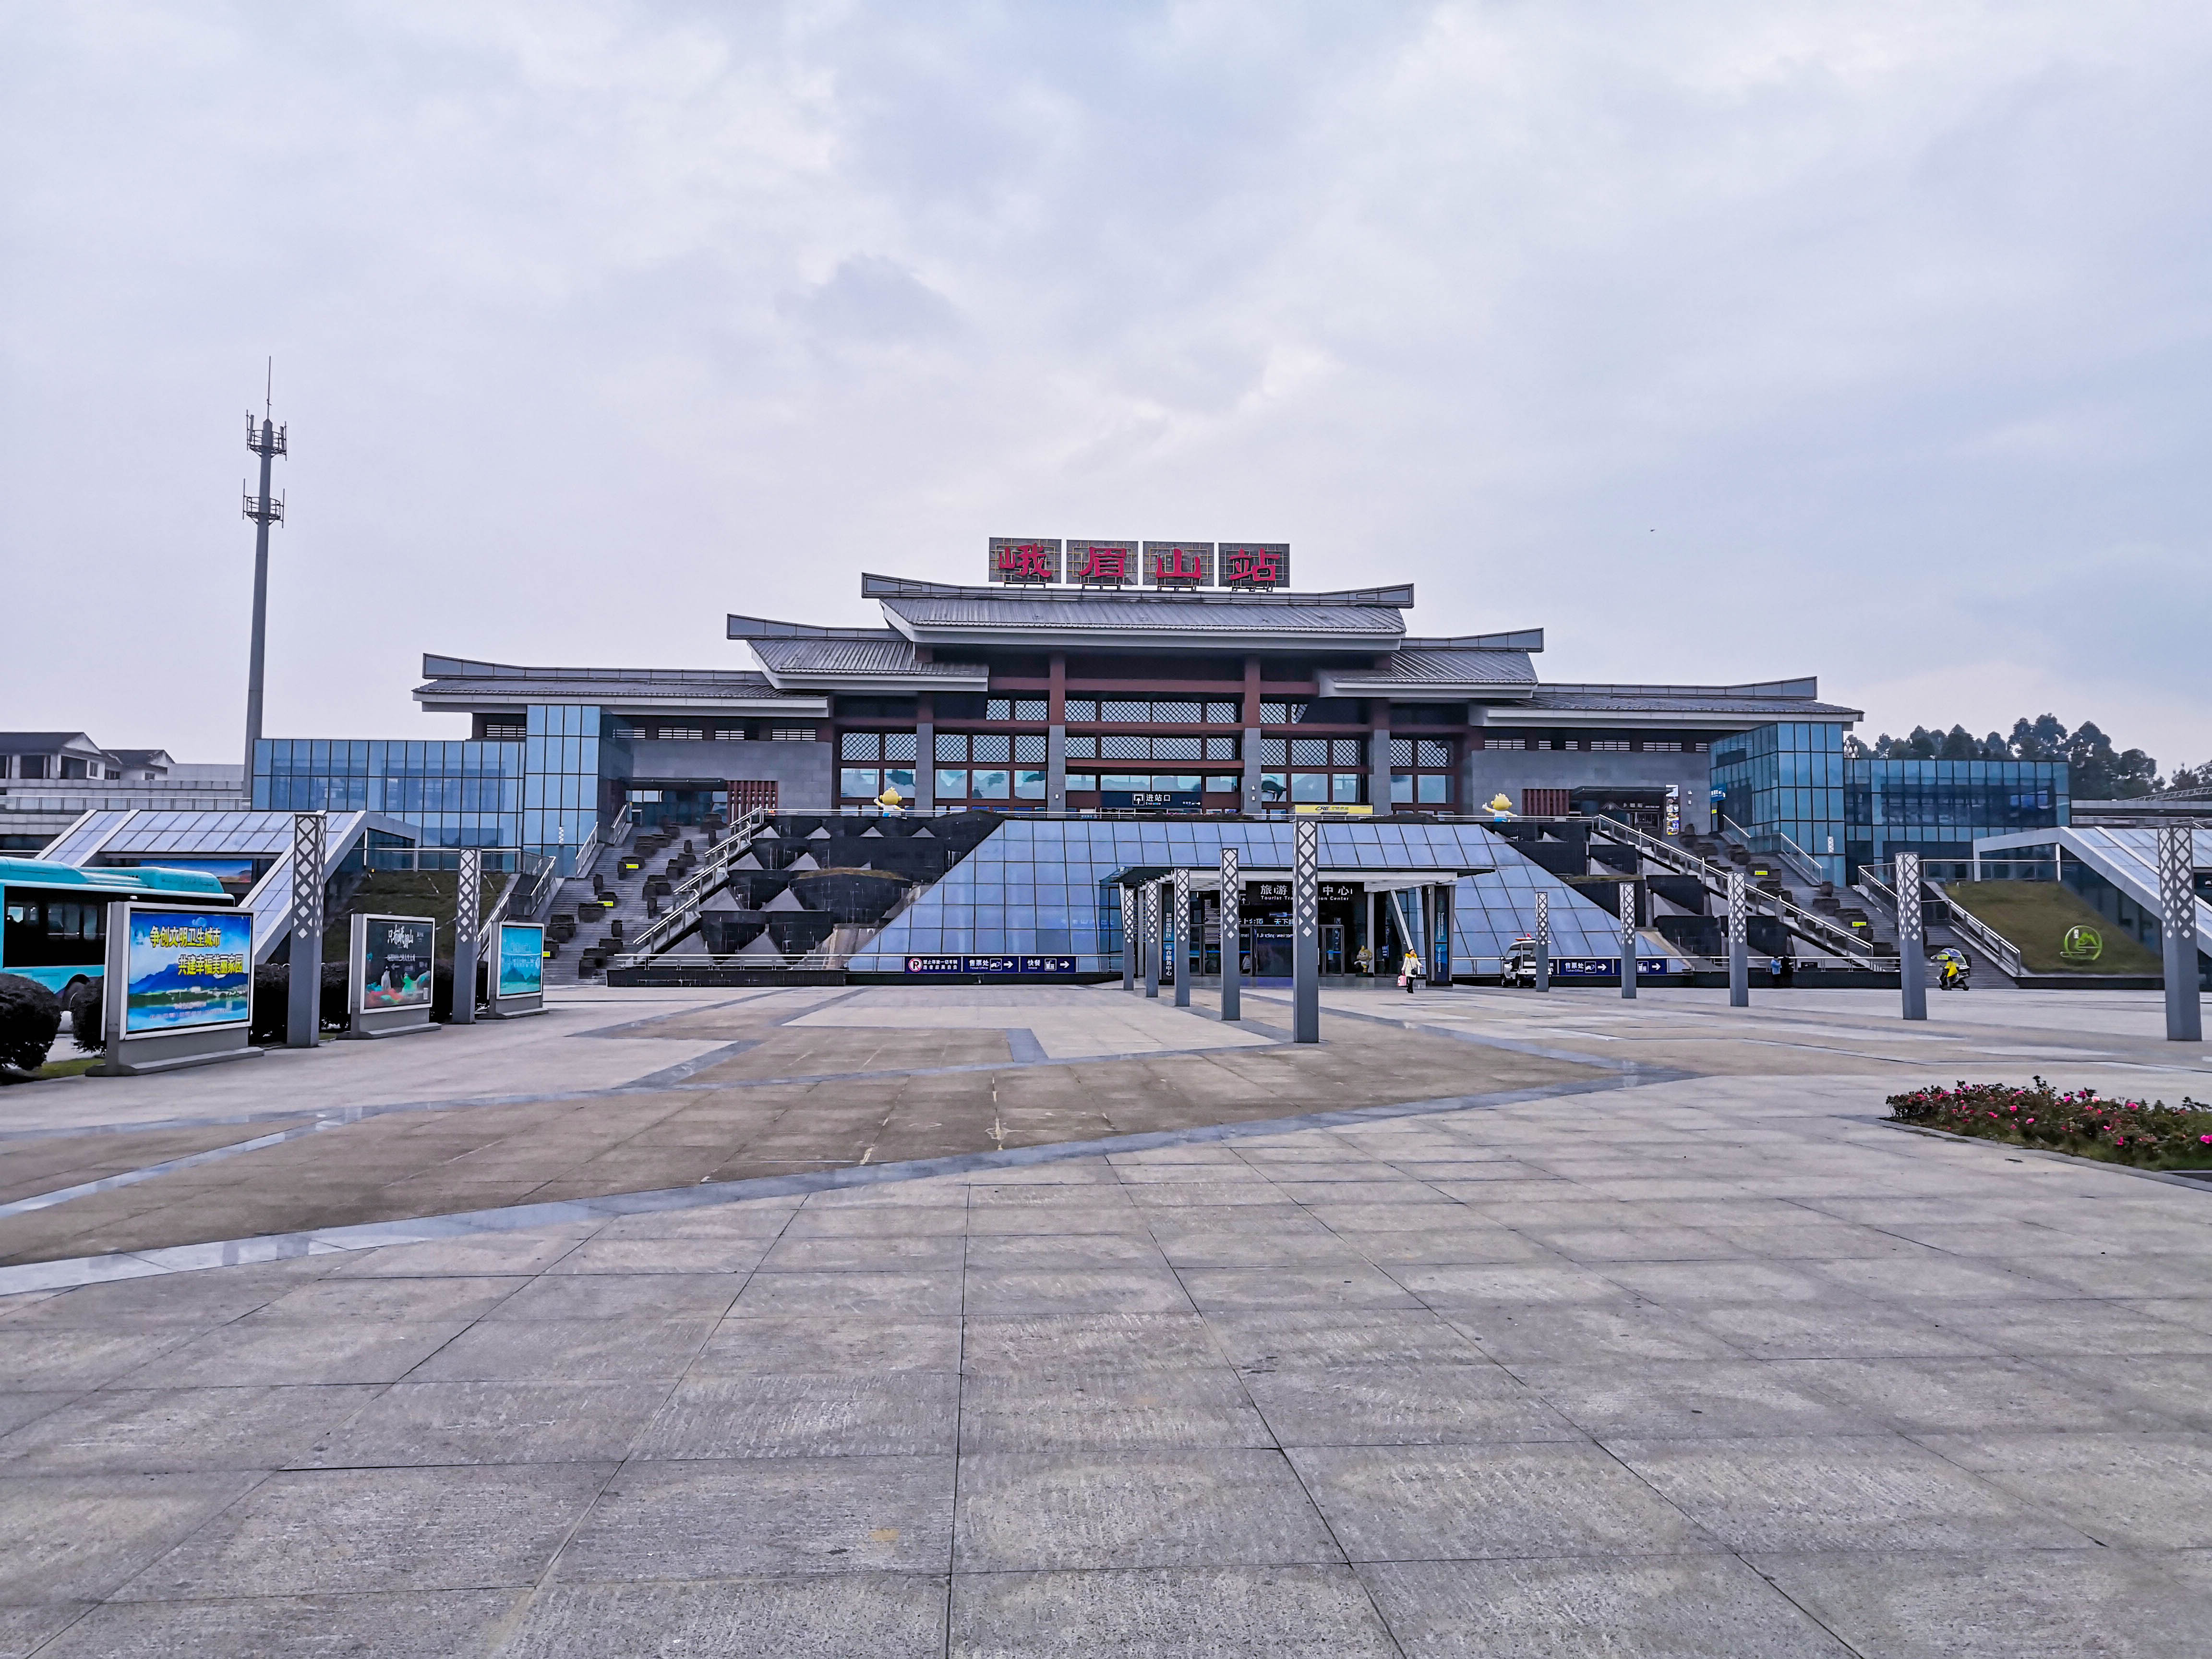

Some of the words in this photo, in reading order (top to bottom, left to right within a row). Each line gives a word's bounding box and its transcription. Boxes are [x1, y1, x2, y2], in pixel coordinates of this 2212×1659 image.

[998, 543, 1280, 582] 峨眉山站
[1145, 793, 1171, 802] 进站口
[1260, 884, 1350, 896] 旅游中心
[150, 926, 221, 948] 争创文明卫生城市
[178, 954, 243, 975] 共建幸福美丽家园
